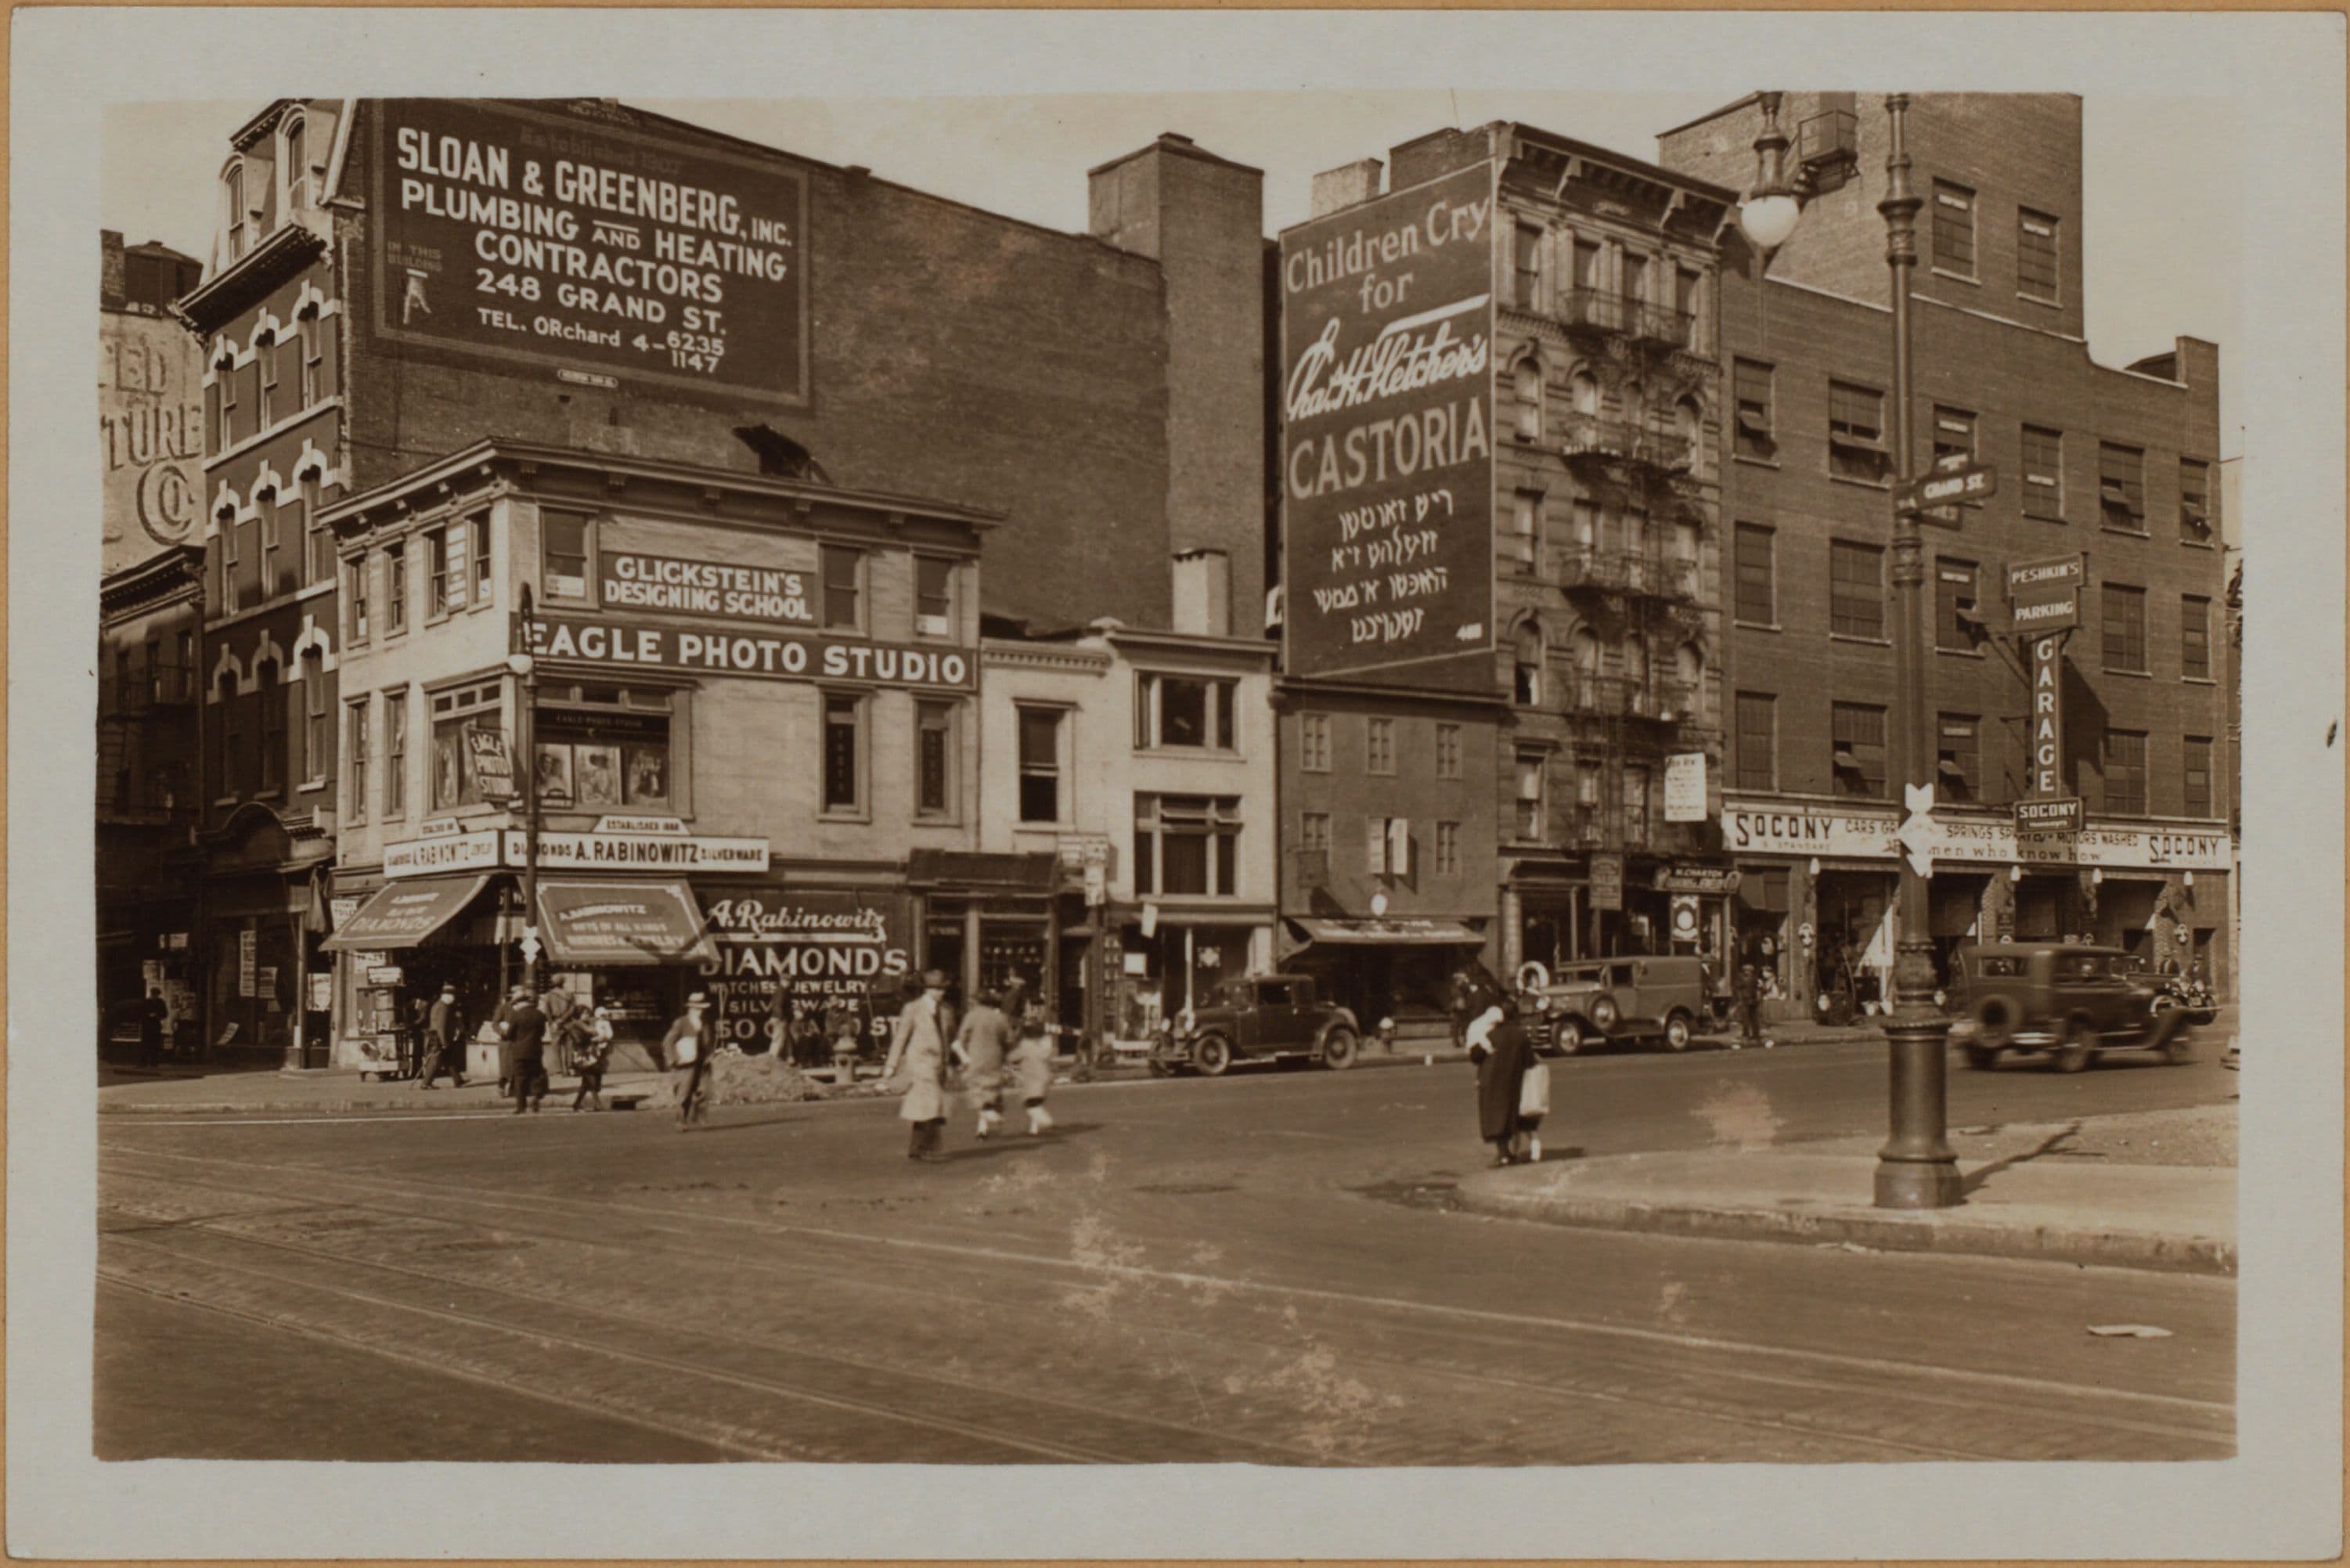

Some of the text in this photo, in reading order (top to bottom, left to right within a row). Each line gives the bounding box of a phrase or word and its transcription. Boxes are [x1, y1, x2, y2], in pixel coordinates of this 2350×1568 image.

[397, 126, 792, 247] SLOAN & GREENBERG, INC.
[402, 179, 787, 281] PLUMBING AND HEATING
[1287, 196, 1489, 294] Children Cry
[409, 245, 442, 259] THIS
[475, 230, 723, 304] CONTRACTORS
[476, 268, 727, 336] 248 GRAND ST.
[1359, 272, 1414, 313] for
[478, 308, 527, 332] TEL.
[533, 315, 621, 348] ORchard
[672, 349, 719, 373] 1147
[1289, 396, 1490, 499] CASTORIA
[615, 557, 803, 595] GLICKSTEIN'S
[605, 581, 720, 612] DESIGNING
[725, 593, 813, 621] SCHOOL
[2015, 601, 2073, 620] PARKING
[532, 623, 965, 684] EAGLE PHOTO STUDIO
[2037, 640, 2055, 791] GARAGE
[1736, 813, 1833, 845] SOCONY
[2019, 802, 2077, 818] SOCONY
[575, 841, 591, 861] A.
[594, 841, 699, 863] RABINOWITZ
[701, 848, 762, 861] SILVERWARE
[1845, 820, 1875, 834] CARS
[1947, 825, 1992, 839] SPRINGS
[2102, 834, 2138, 847] WASHED
[1973, 844, 2007, 857] who
[2017, 845, 2061, 860] know
[2068, 846, 2102, 862] how
[2150, 836, 2218, 863] SOCONY
[734, 899, 887, 943] Rabinowitz
[708, 980, 867, 994] WATCHES JEWELRY
